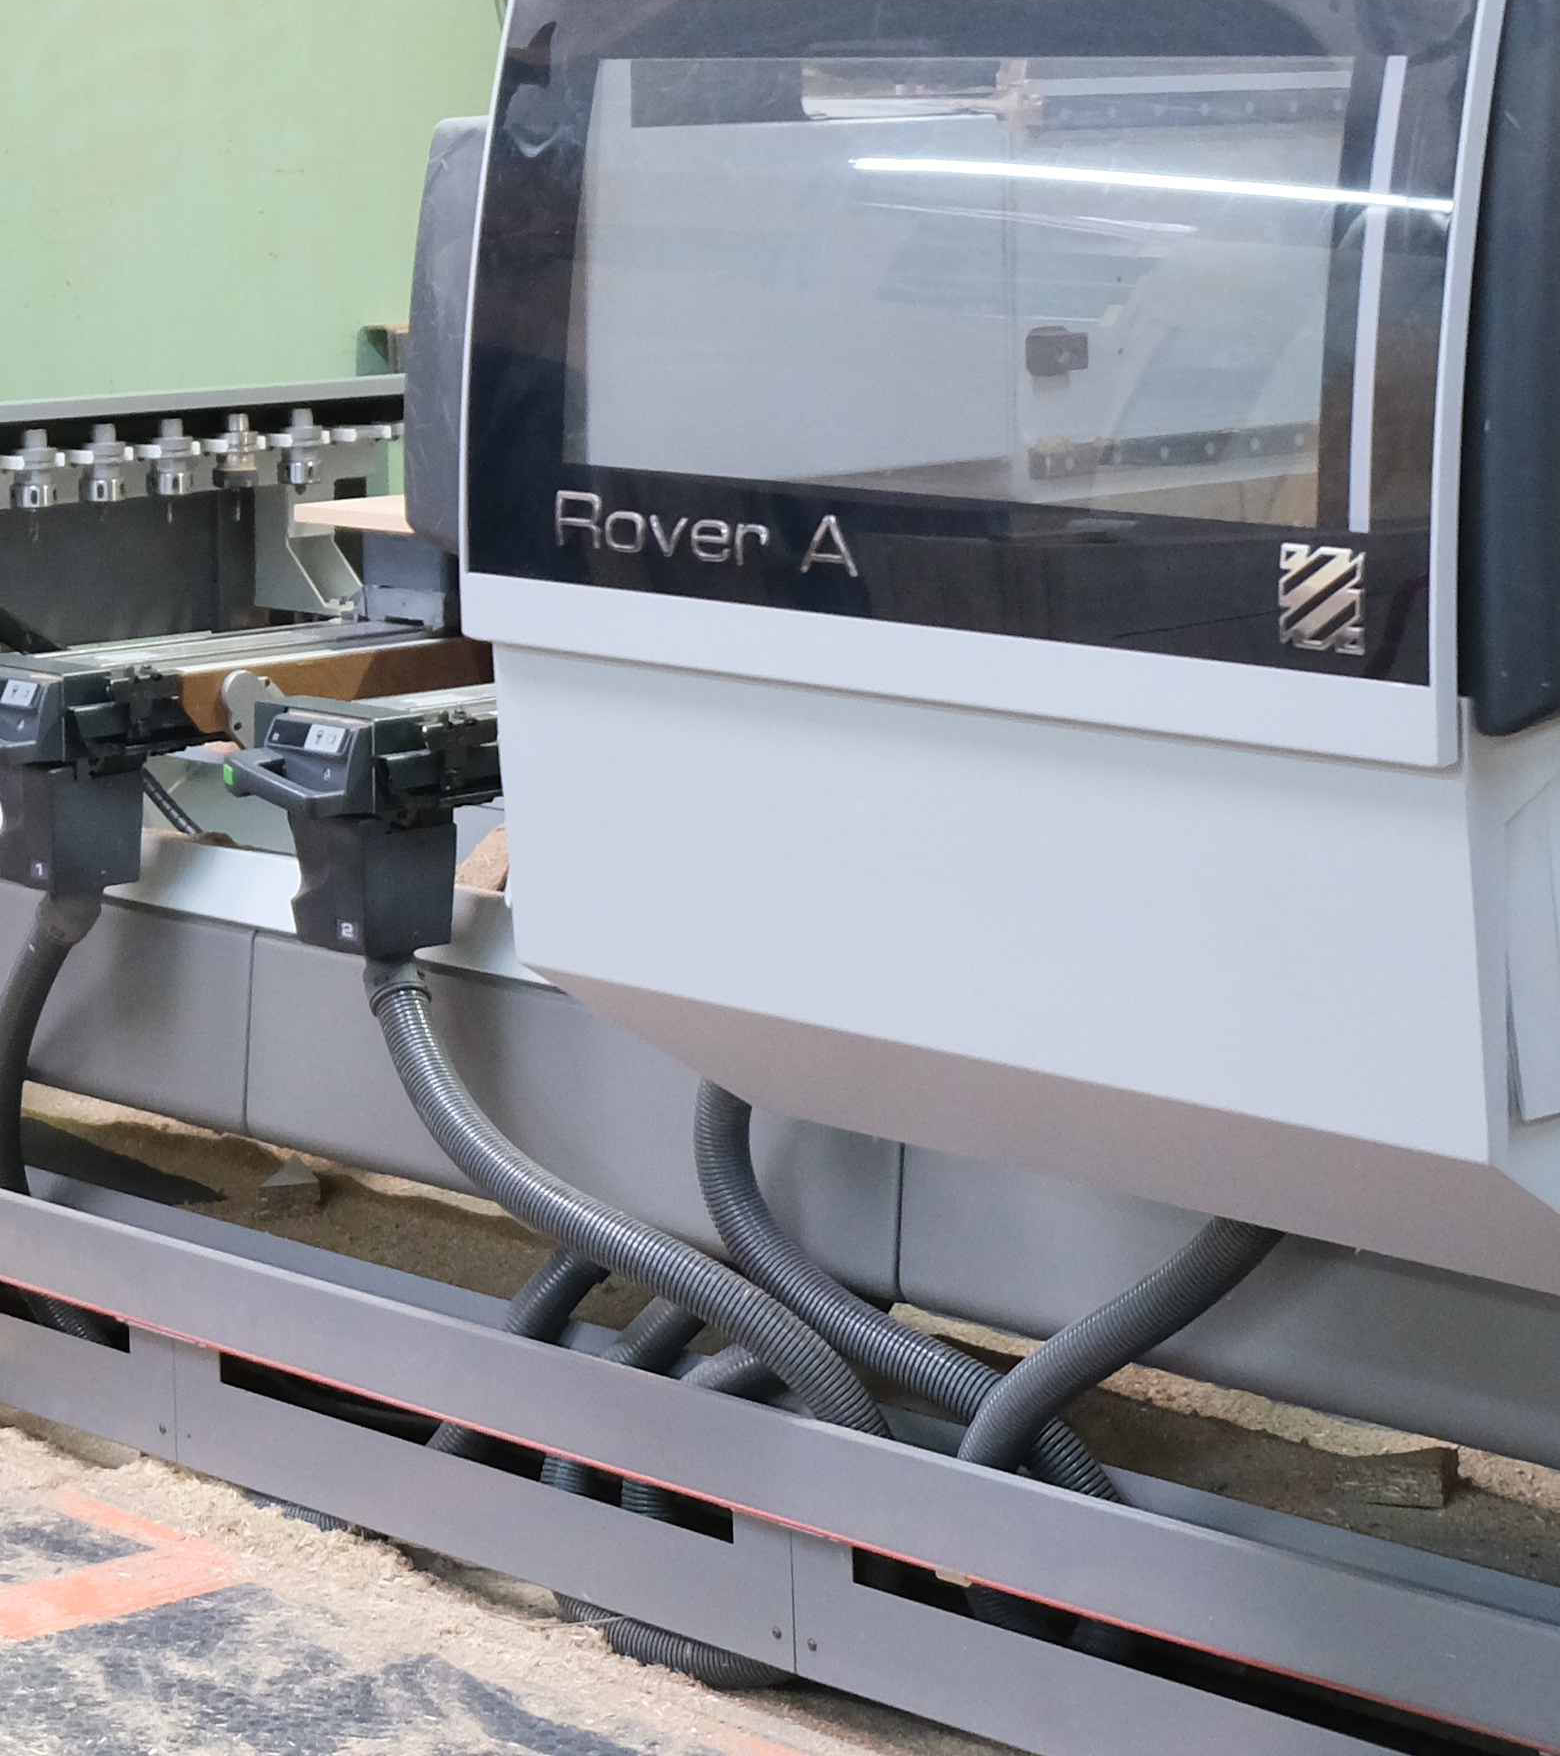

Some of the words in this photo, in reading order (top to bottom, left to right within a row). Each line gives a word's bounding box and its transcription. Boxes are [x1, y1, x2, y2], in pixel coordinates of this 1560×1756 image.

[555, 490, 769, 566] Rover
[800, 514, 859, 578] A
[35, 862, 44, 876] 1
[340, 921, 354, 938] 2
